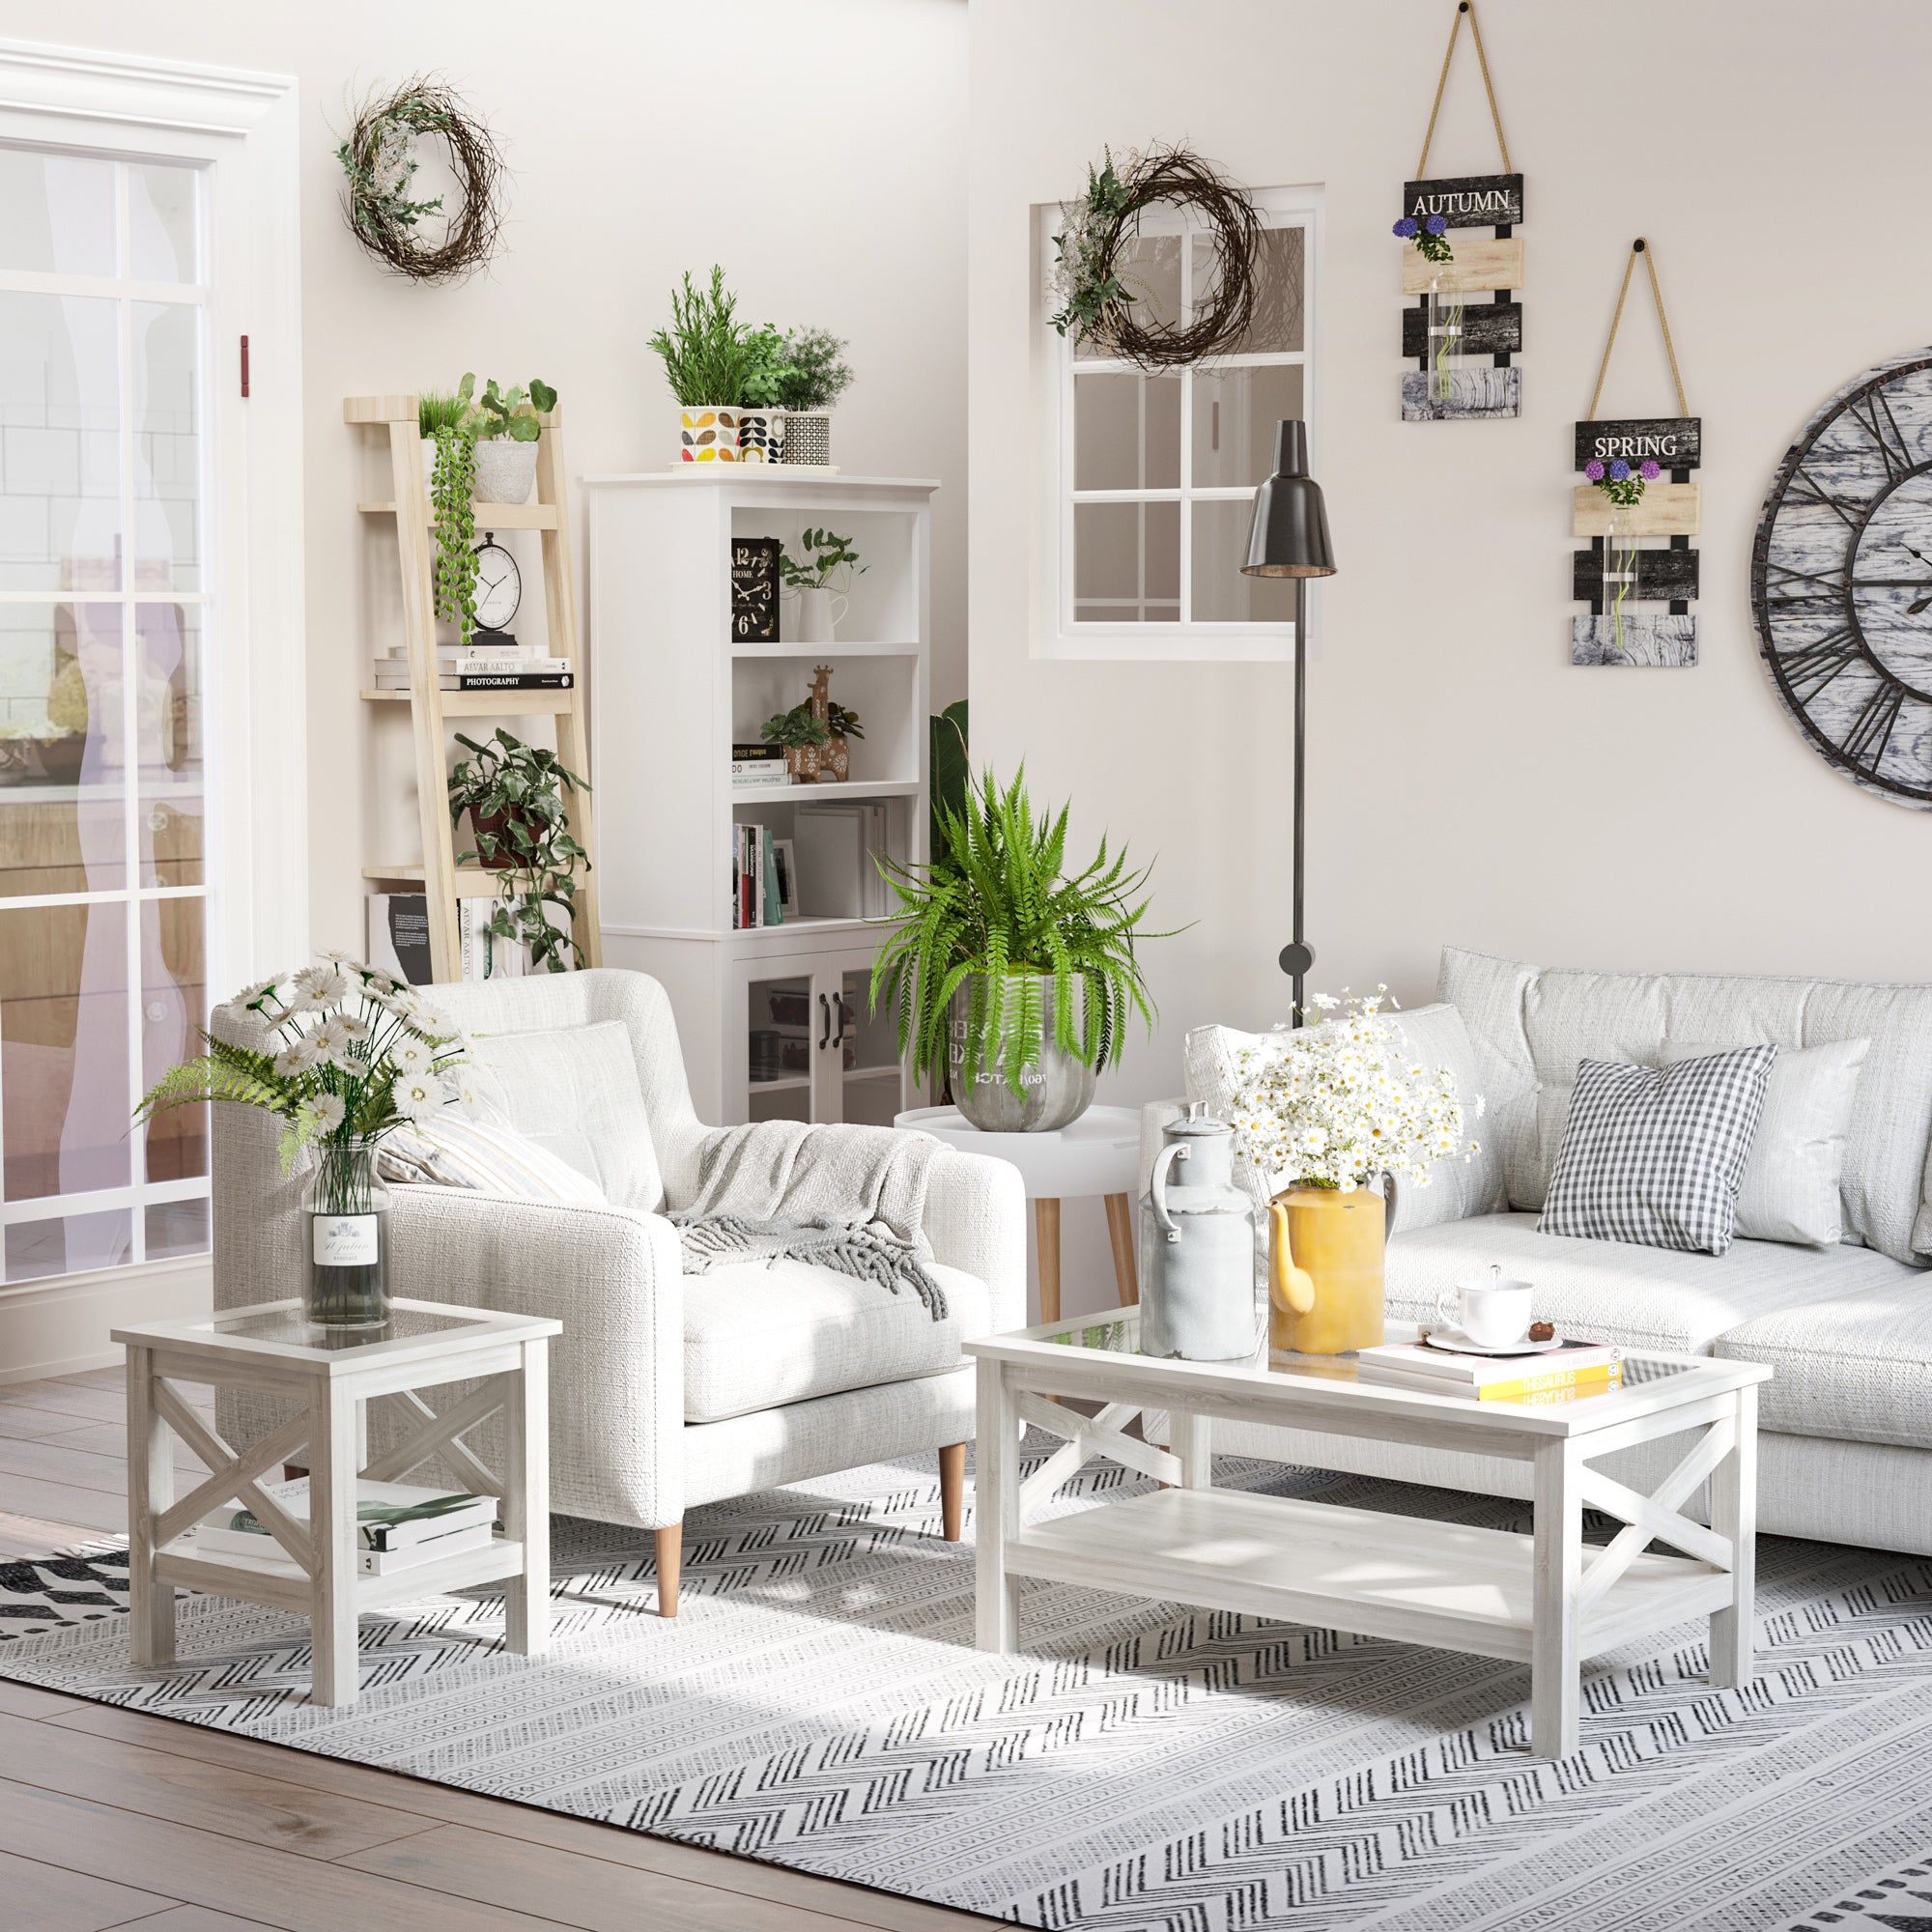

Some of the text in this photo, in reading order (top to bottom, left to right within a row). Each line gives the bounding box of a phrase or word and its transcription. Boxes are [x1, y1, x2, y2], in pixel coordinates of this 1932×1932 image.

[1411, 189, 1511, 216] AUTUMN
[1594, 435, 1678, 459] SPRING
[736, 547, 750, 565] 12
[732, 570, 753, 579] HOME
[762, 581, 772, 600] 3
[738, 615, 749, 635] 6
[464, 662, 516, 672] ALVAR AALTO
[466, 677, 520, 686] PHOTOGRAPHY
[1522, 1371, 1576, 1392] THESAURUS
